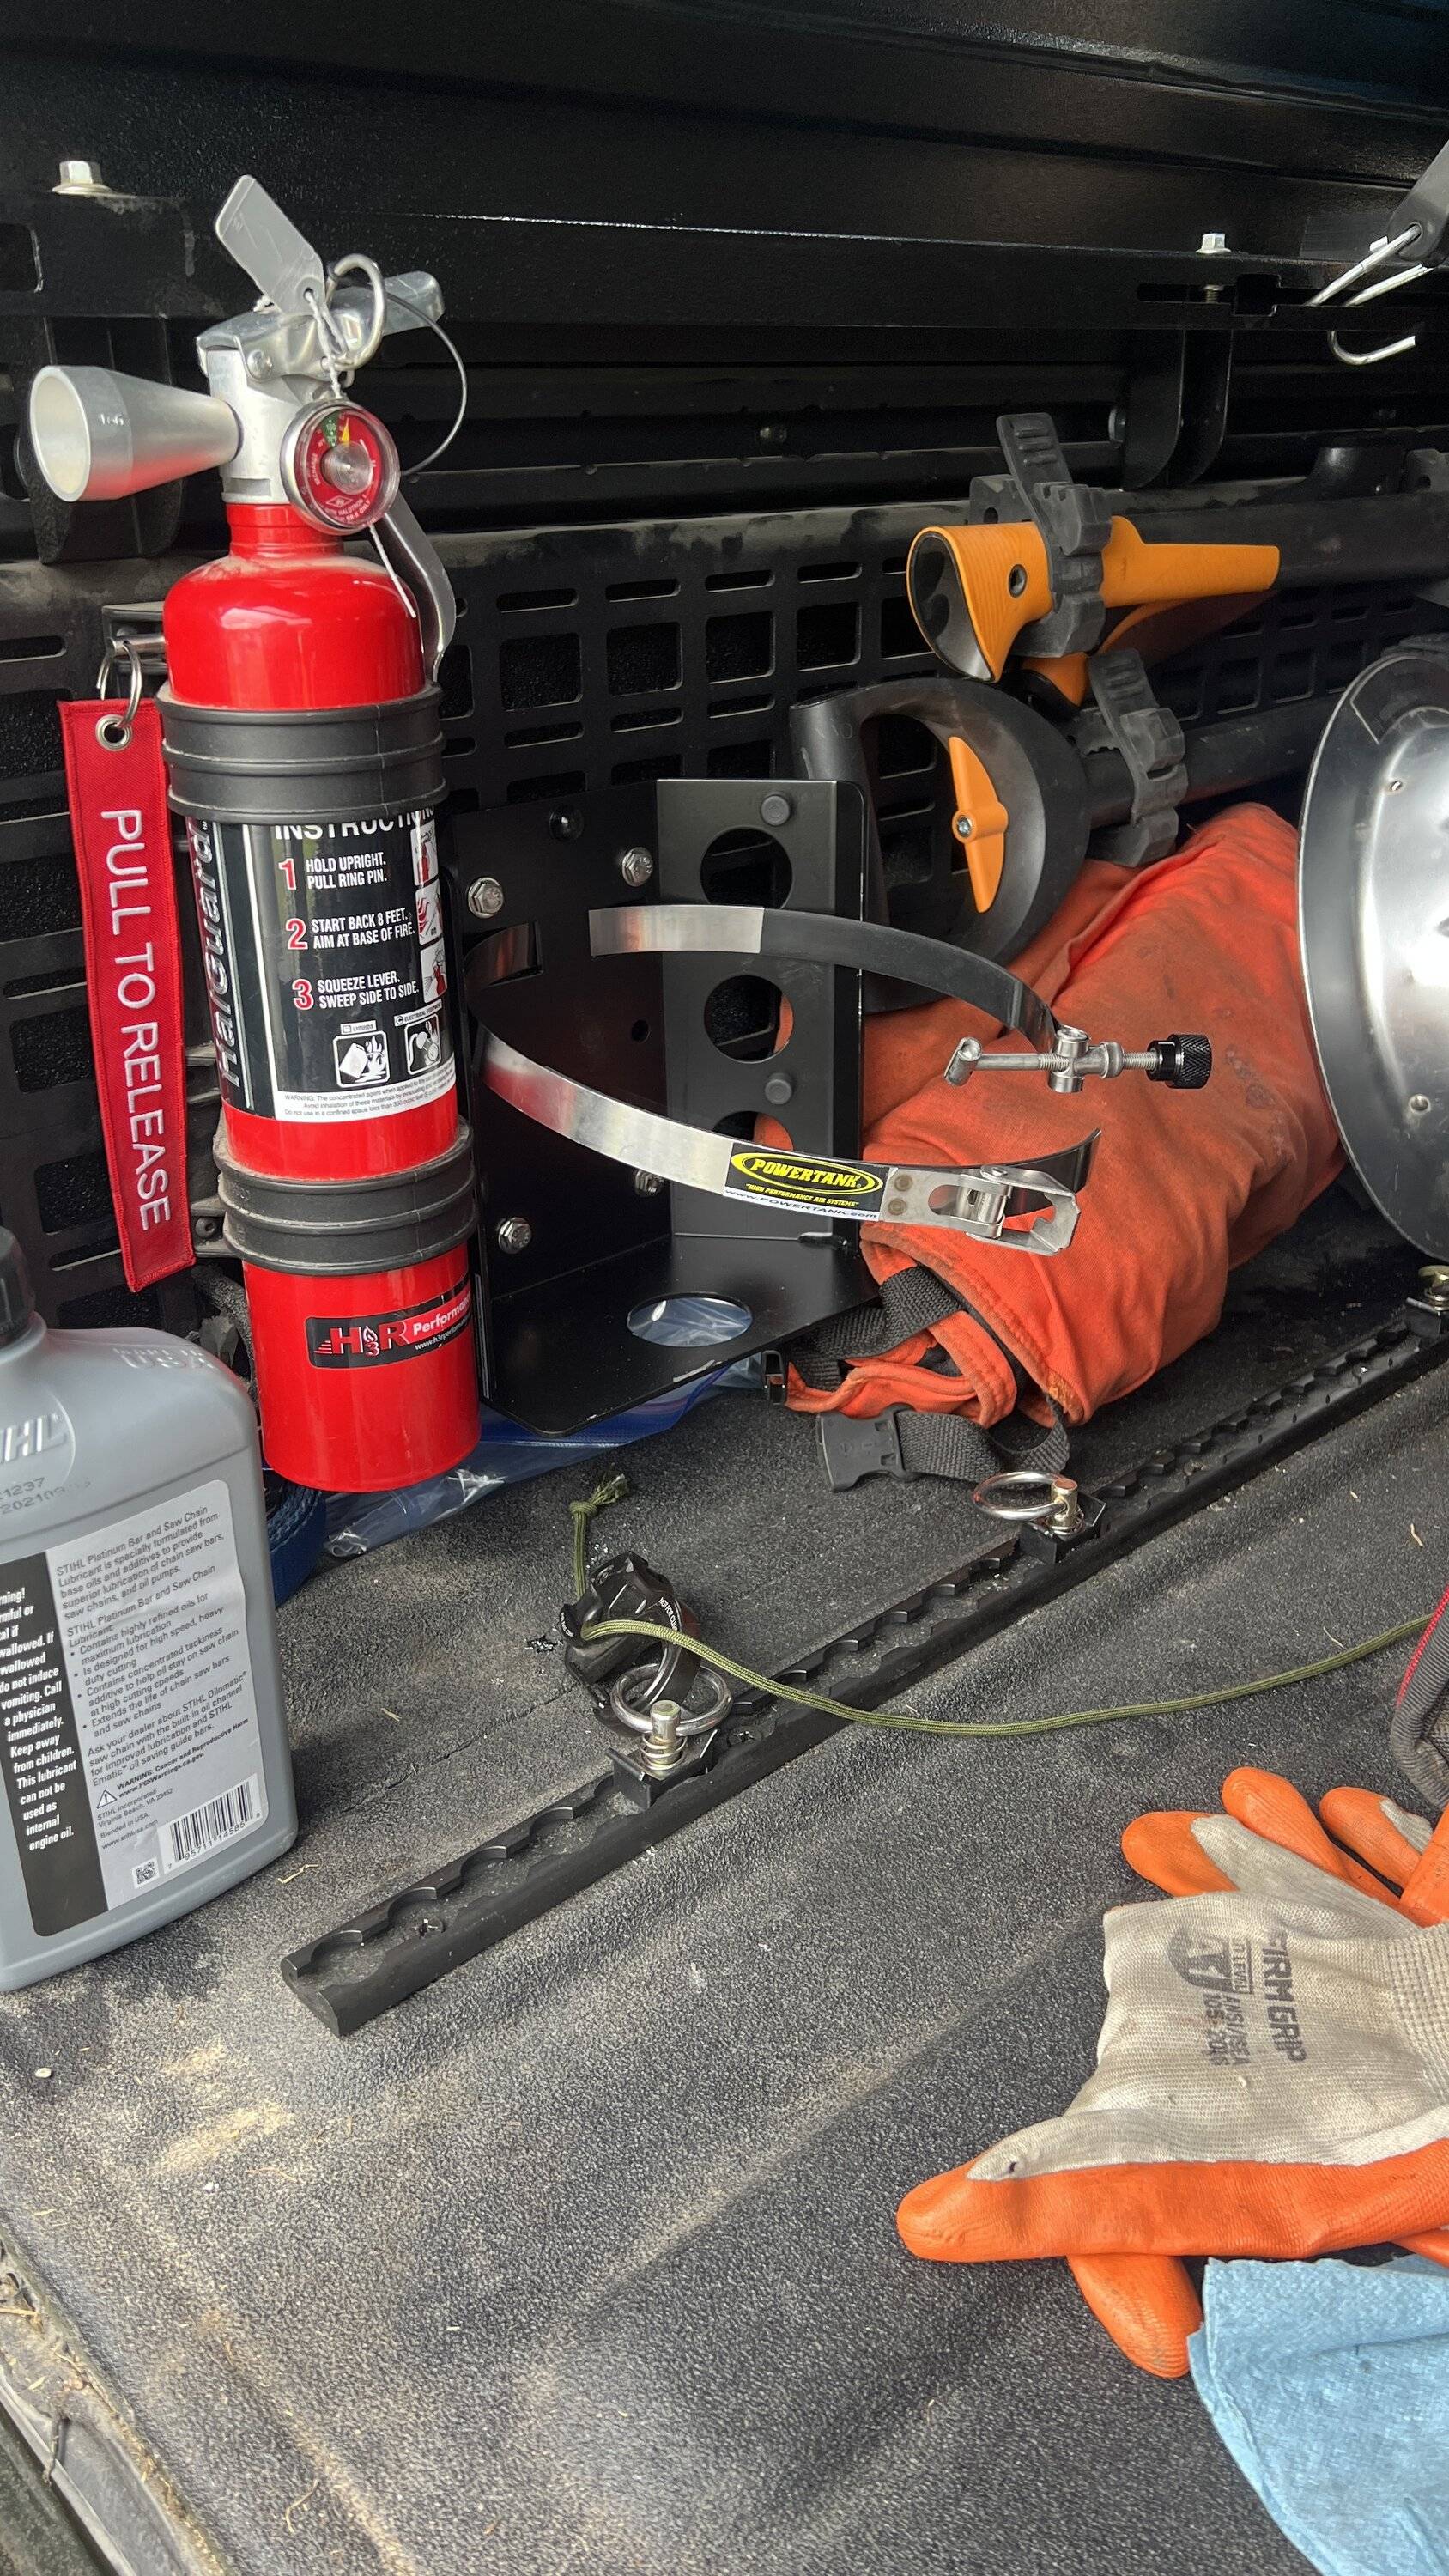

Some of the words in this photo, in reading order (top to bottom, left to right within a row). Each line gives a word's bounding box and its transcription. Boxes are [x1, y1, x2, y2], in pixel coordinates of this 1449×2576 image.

[100, 809, 152, 936] PULL
[278, 858, 297, 890] 1
[306, 858, 336, 873] HOLD
[338, 852, 386, 871] UPRIGHT.
[307, 873, 337, 890] PULL
[338, 871, 365, 888] RING
[367, 869, 387, 884] PIN.
[285, 918, 308, 950] 2
[312, 917, 346, 933] START
[348, 912, 375, 931] BACK
[378, 912, 384, 927] 8
[385, 908, 408, 925] FEET.
[313, 935, 336, 950] AIM
[336, 933, 351, 948] AT
[352, 929, 379, 946] BASE
[380, 927, 393, 942] OF
[395, 921, 415, 939] FIRE.
[115, 942, 157, 1010] TO
[292, 978, 314, 1011] 3
[317, 975, 366, 993] SQUEEZE
[367, 970, 401, 988] LEVER.
[318, 993, 357, 1009] SWEEP
[359, 988, 383, 1005] SIDE
[384, 986, 397, 1001] TO
[398, 981, 420, 997] SIDE.
[120, 1022, 171, 1231] RELEASE
[749, 1158, 861, 1188] POWERTANK
[765, 1187, 814, 1201] PERFORMANCE
[57, 1559, 86, 1576] STIHL
[88, 1544, 125, 1564] Platinum
[128, 1535, 142, 1547] Bar
[146, 1525, 161, 1539] and
[164, 1518, 182, 1531] Saw
[185, 1507, 207, 1522] Chain
[59, 1564, 102, 1587] Lubricant
[114, 1544, 151, 1564] specially
[154, 1521, 197, 1546] formulated
[200, 1514, 218, 1526] from
[61, 1586, 83, 1598] base
[87, 1578, 101, 1589] oils
[104, 1568, 120, 1581] and
[124, 1552, 161, 1573] additives
[173, 1532, 203, 1552] provide
[63, 1589, 100, 1608] superior
[103, 1569, 149, 1594] lubrication
[151, 1561, 158, 1571] of
[161, 1552, 184, 1567] chain
[185, 1543, 202, 1556] saw
[64, 1608, 84, 1619] saw
[122, 1583, 136, 1597] and
[139, 1578, 149, 1589] oil
[151, 1566, 180, 1585] pumps.
[24, 1606, 33, 1616] or
[11, 1625, 18, 1637] if
[46, 1631, 54, 1643] If
[0, 1652, 45, 1675] wallowed
[0, 1681, 9, 1693] do
[11, 1677, 27, 1690] not
[28, 1668, 59, 1684] induce
[89, 1688, 123, 1706] additive
[136, 1674, 155, 1686] help
[157, 1665, 167, 1676] oil
[168, 1657, 185, 1670] stay
[187, 1652, 197, 1661] on
[199, 1642, 215, 1655] saw
[218, 1630, 239, 1644] chain
[1, 1692, 42, 1710] vomiting.
[45, 1680, 62, 1696] Call
[92, 1708, 126, 1727] Extends
[129, 1701, 142, 1710] the
[145, 1693, 157, 1704] life
[160, 1686, 167, 1696] of
[170, 1676, 192, 1691] chain
[194, 1666, 210, 1679] saw
[212, 1656, 229, 1669] bars
[4, 1717, 10, 1726] a
[13, 1703, 56, 1726] physician
[8, 1716, 64, 1741] immediately.
[88, 1745, 105, 1757] Ask
[106, 1735, 126, 1750] your
[129, 1722, 155, 1739] dealer
[158, 1709, 181, 1724] about
[183, 1695, 205, 1712] STIHL
[90, 1755, 108, 1766] saw
[111, 1743, 134, 1757] chain
[136, 1733, 155, 1745] with
[157, 1726, 170, 1735] the
[172, 1710, 199, 1728] built-in
[202, 1702, 210, 1713] oil
[213, 1684, 242, 1706] channel
[94, 1723, 110, 1737] and
[113, 1716, 130, 1729] saw
[134, 1703, 161, 1719] chains
[10, 1743, 33, 1758] Keep
[35, 1735, 60, 1749] away
[91, 1766, 102, 1776] for
[106, 1746, 145, 1770] improved
[148, 1725, 191, 1751] lubrication
[192, 1714, 207, 1728] and
[209, 1702, 232, 1718] STIHL
[130, 1759, 139, 1770] oil
[142, 1747, 168, 1765] saving
[171, 1735, 192, 1751] guide
[195, 1724, 214, 1737] bars.
[155, 1758, 178, 1771] Cancer
[179, 1749, 191, 1759] and
[192, 1728, 232, 1753] Reproductive
[233, 1719, 248, 1730] Harm
[13, 1759, 34, 1774] from
[36, 1747, 75, 1765] children.
[16, 1776, 36, 1789] This
[38, 1760, 76, 1783] lubricant
[20, 1791, 37, 1805] can
[38, 1786, 53, 1799] not
[54, 1782, 66, 1793] be
[23, 1803, 45, 1820] used
[45, 1802, 58, 1813] as
[26, 1814, 60, 1836] internal
[29, 1835, 59, 1851] engine
[60, 1826, 74, 1839] oil.
[218, 1821, 246, 1841] 14585
[1231, 1955, 1248, 1991] LEVEL
[1262, 1931, 1294, 2002] FIRM
[1268, 2006, 1307, 2062] GRIP
